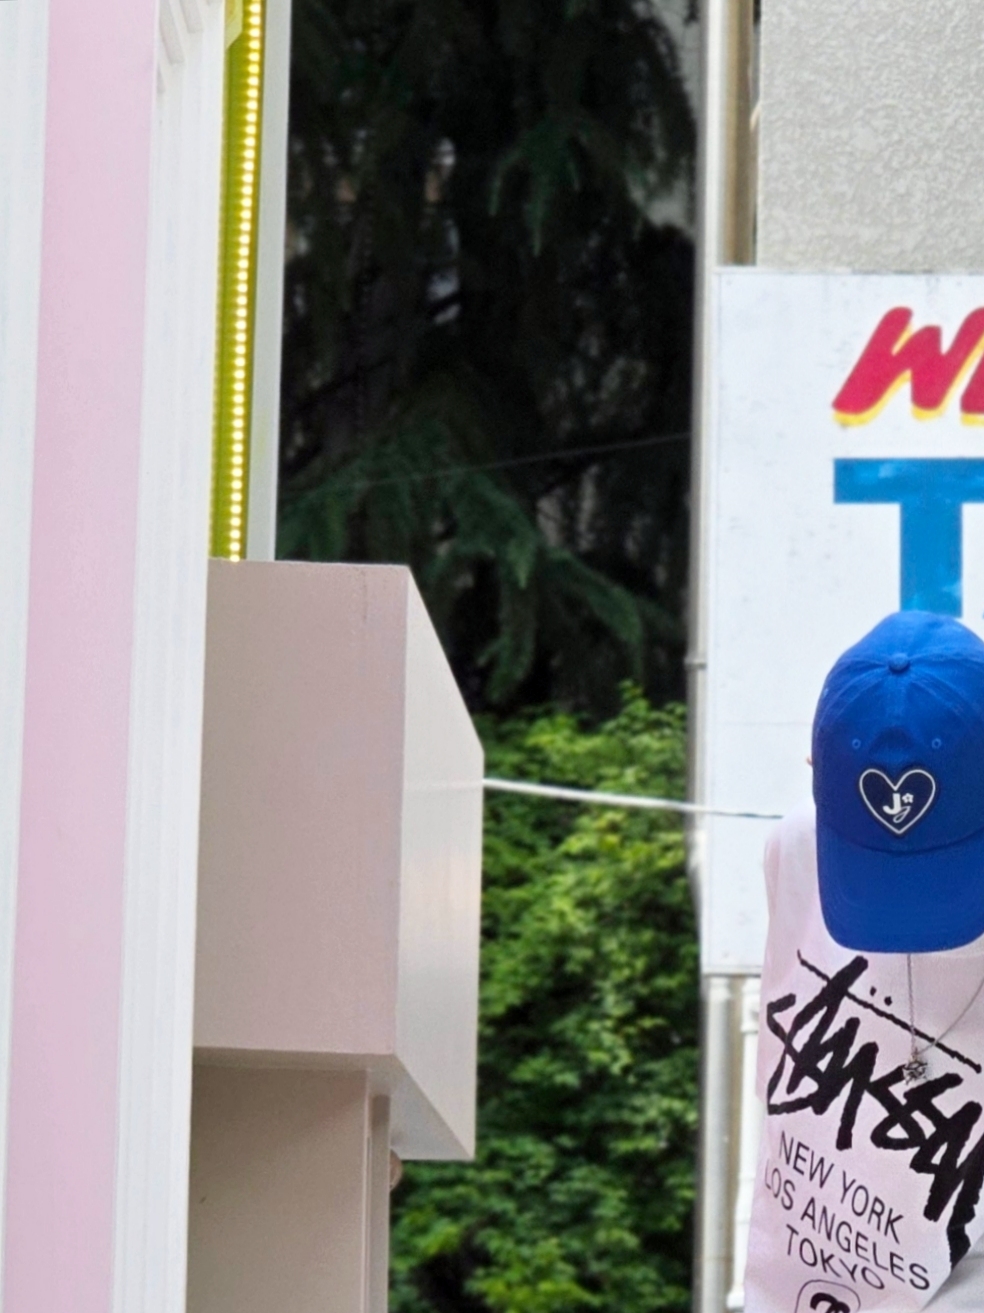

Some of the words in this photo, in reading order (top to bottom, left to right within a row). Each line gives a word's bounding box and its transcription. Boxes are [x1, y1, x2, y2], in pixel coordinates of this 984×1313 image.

[765, 1158, 795, 1211] LOS
[800, 1197, 931, 1291] ANGELES
[779, 1130, 834, 1189] NEW
[840, 1170, 904, 1244] YORK
[786, 1224, 885, 1290] TOKYO
